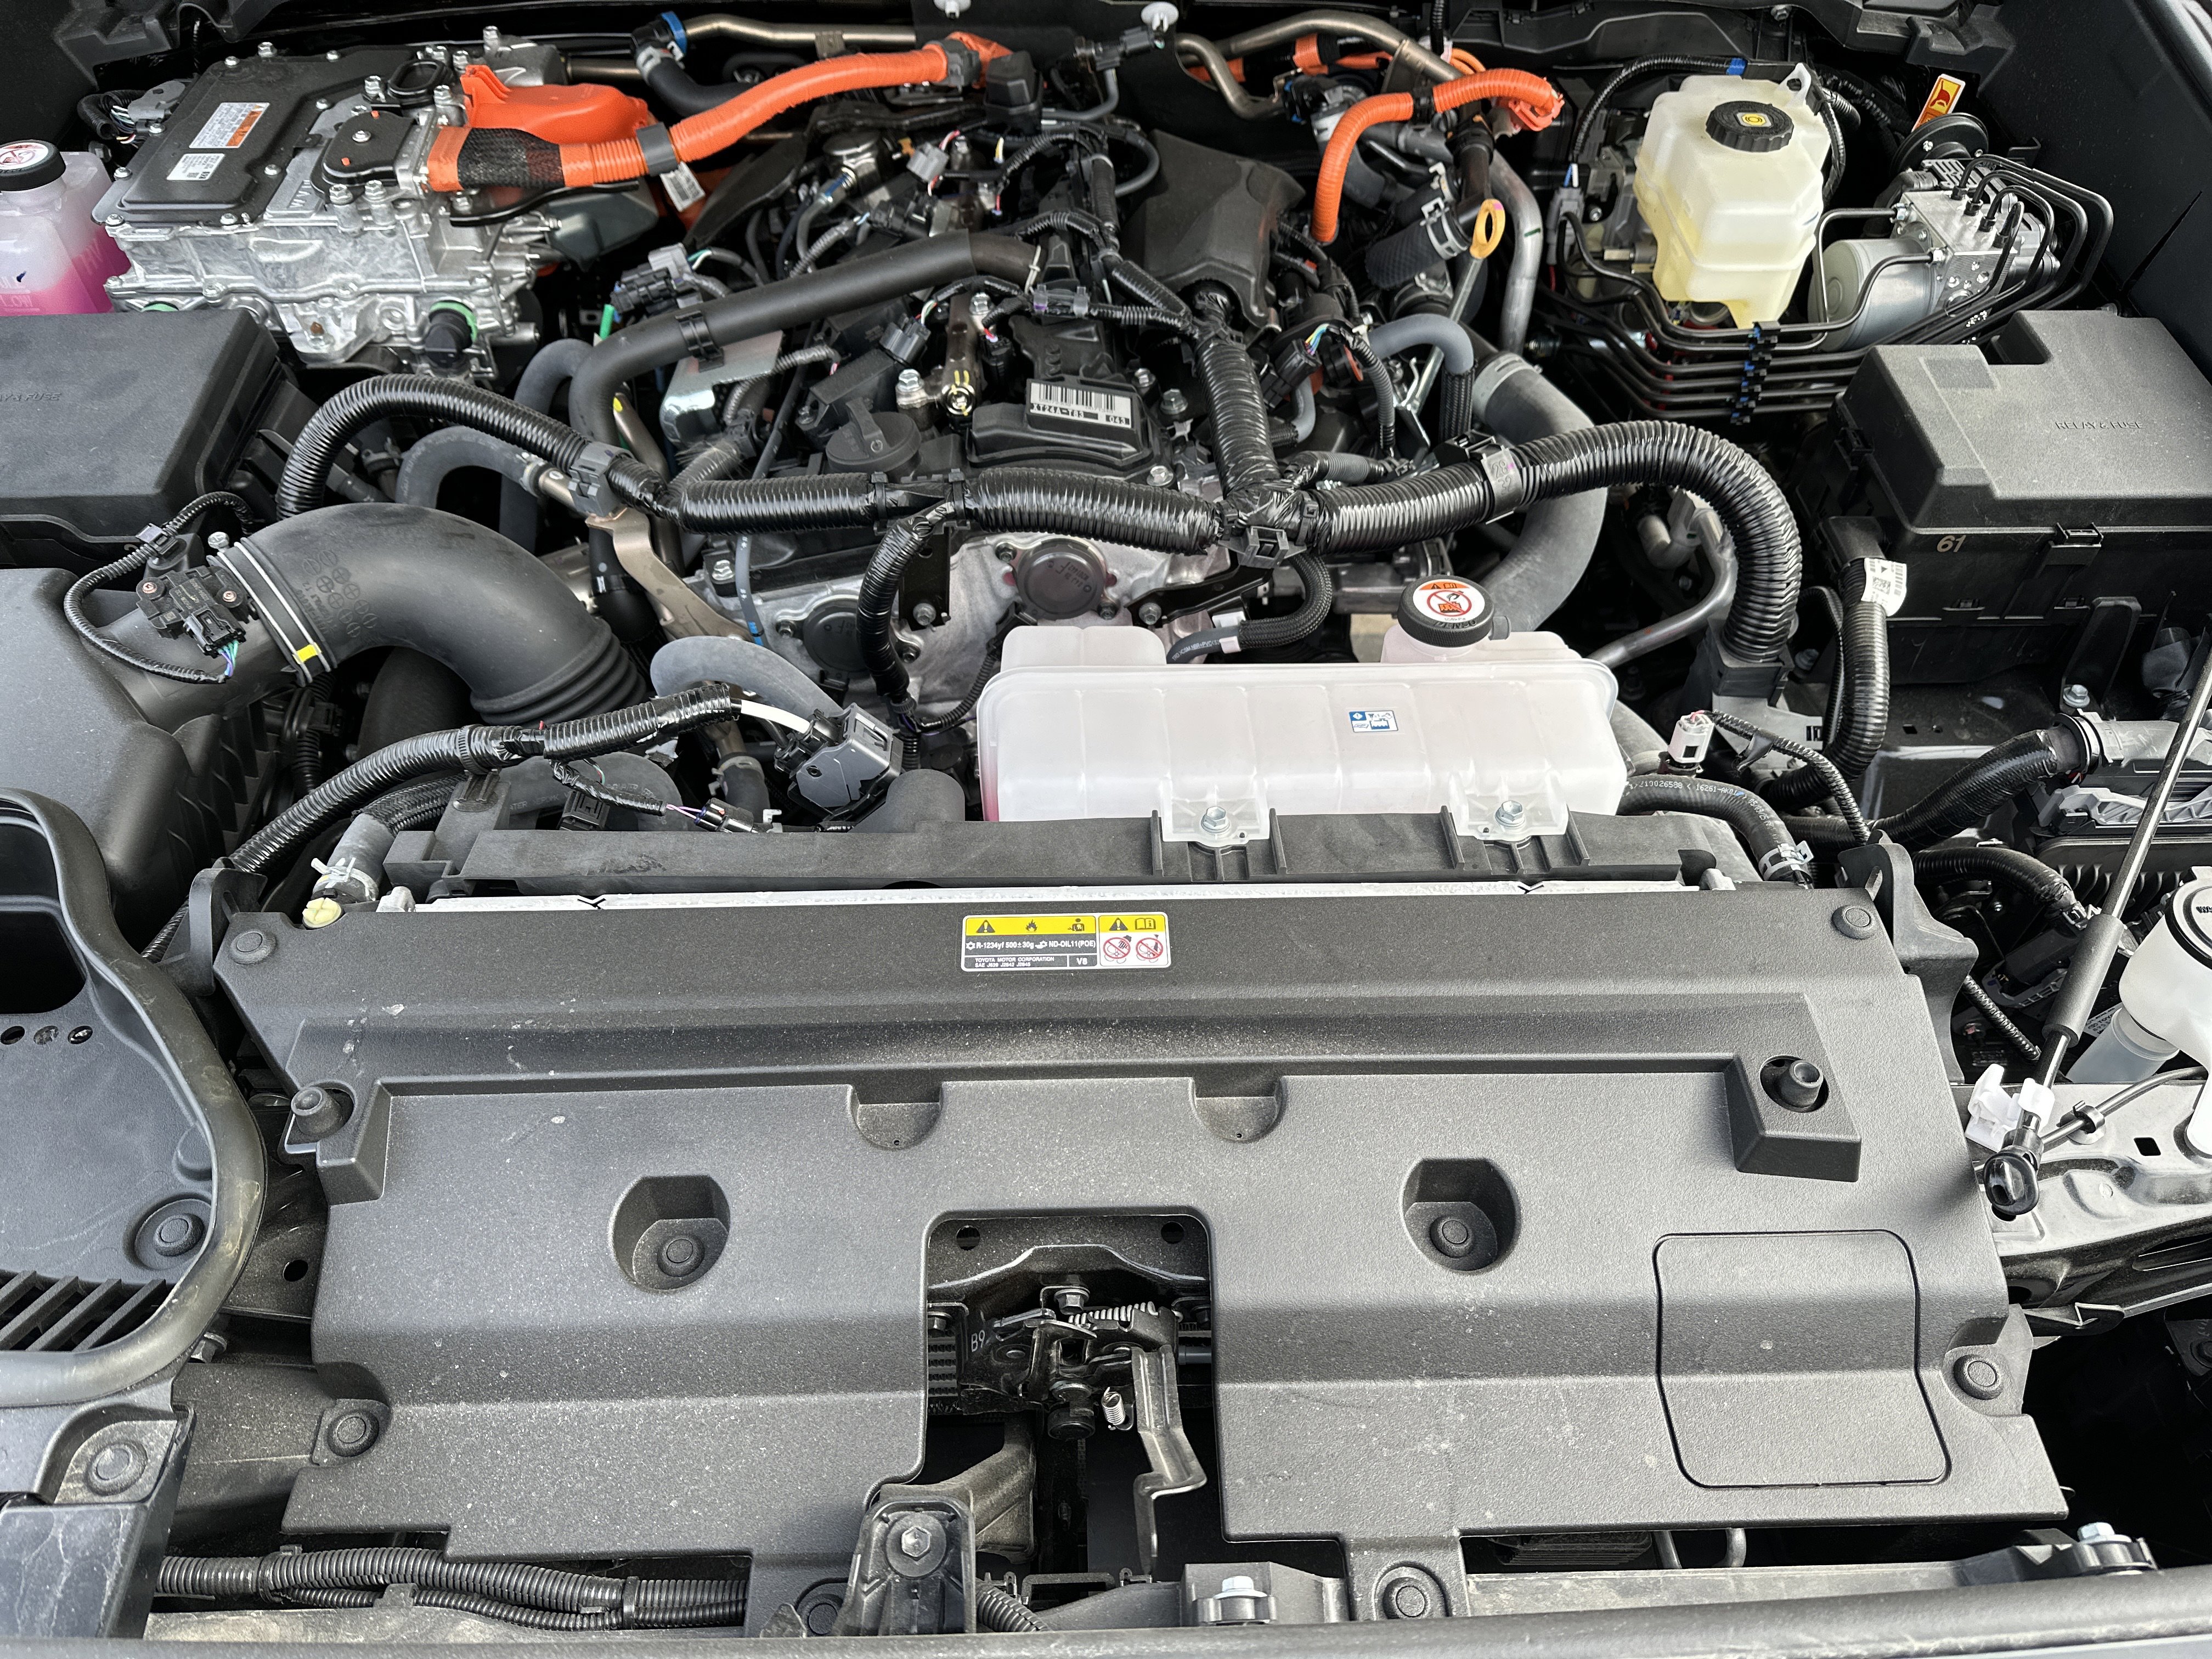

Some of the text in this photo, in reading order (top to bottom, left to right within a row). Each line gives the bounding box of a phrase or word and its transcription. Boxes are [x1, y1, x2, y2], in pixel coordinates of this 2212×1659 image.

[25, 392, 61, 401] FUSE
[1109, 415, 1126, 425] 043
[2055, 421, 2096, 430] RELAY
[1937, 535, 1966, 553] 61
[976, 940, 1096, 950] R-1234yf 500±30g ND-OIL11(POE)
[971, 1329, 986, 1352] B9
